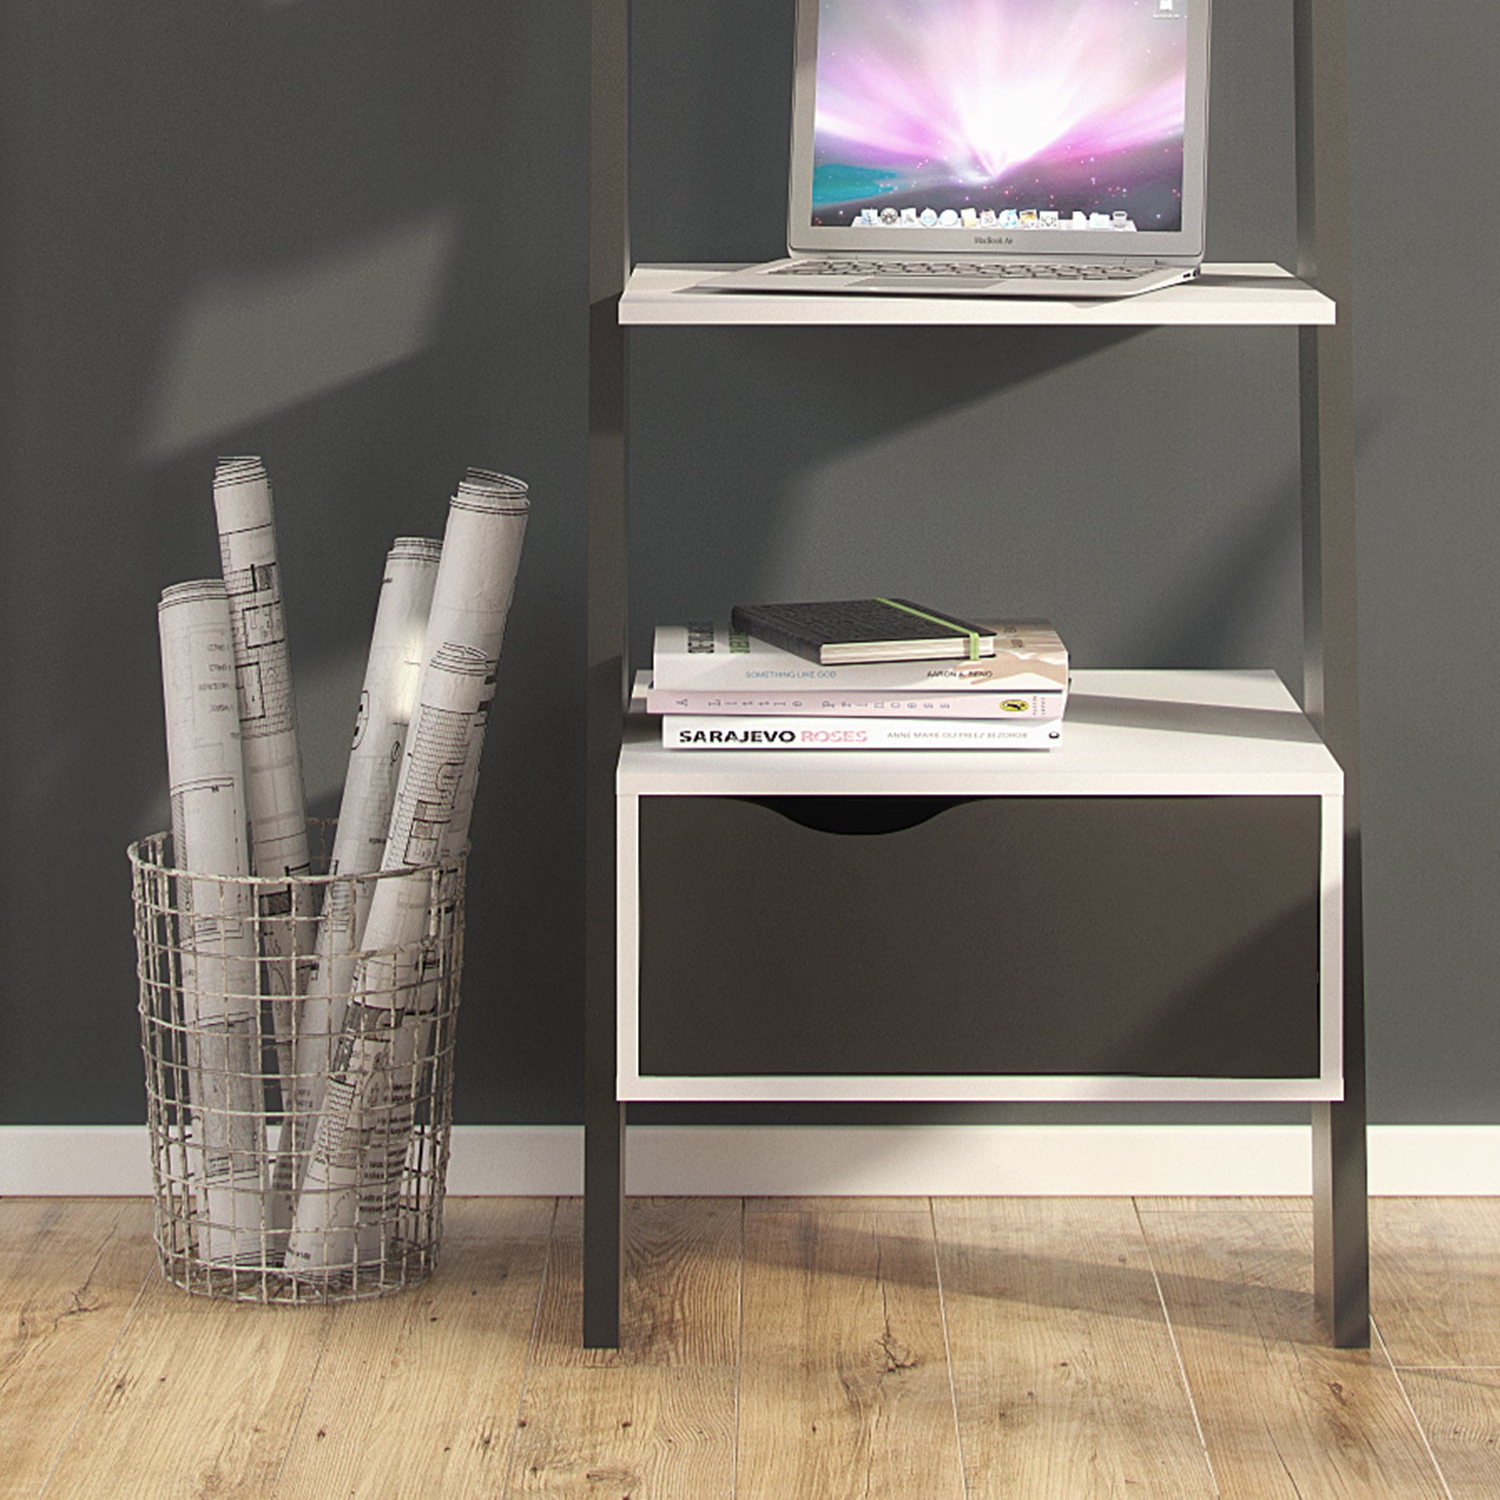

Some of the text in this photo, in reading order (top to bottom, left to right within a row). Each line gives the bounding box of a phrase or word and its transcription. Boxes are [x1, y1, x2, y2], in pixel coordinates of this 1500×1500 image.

[745, 670, 836, 678] SOMETHING LIKE GOD
[679, 729, 868, 743] SARAJEVO ROSES
